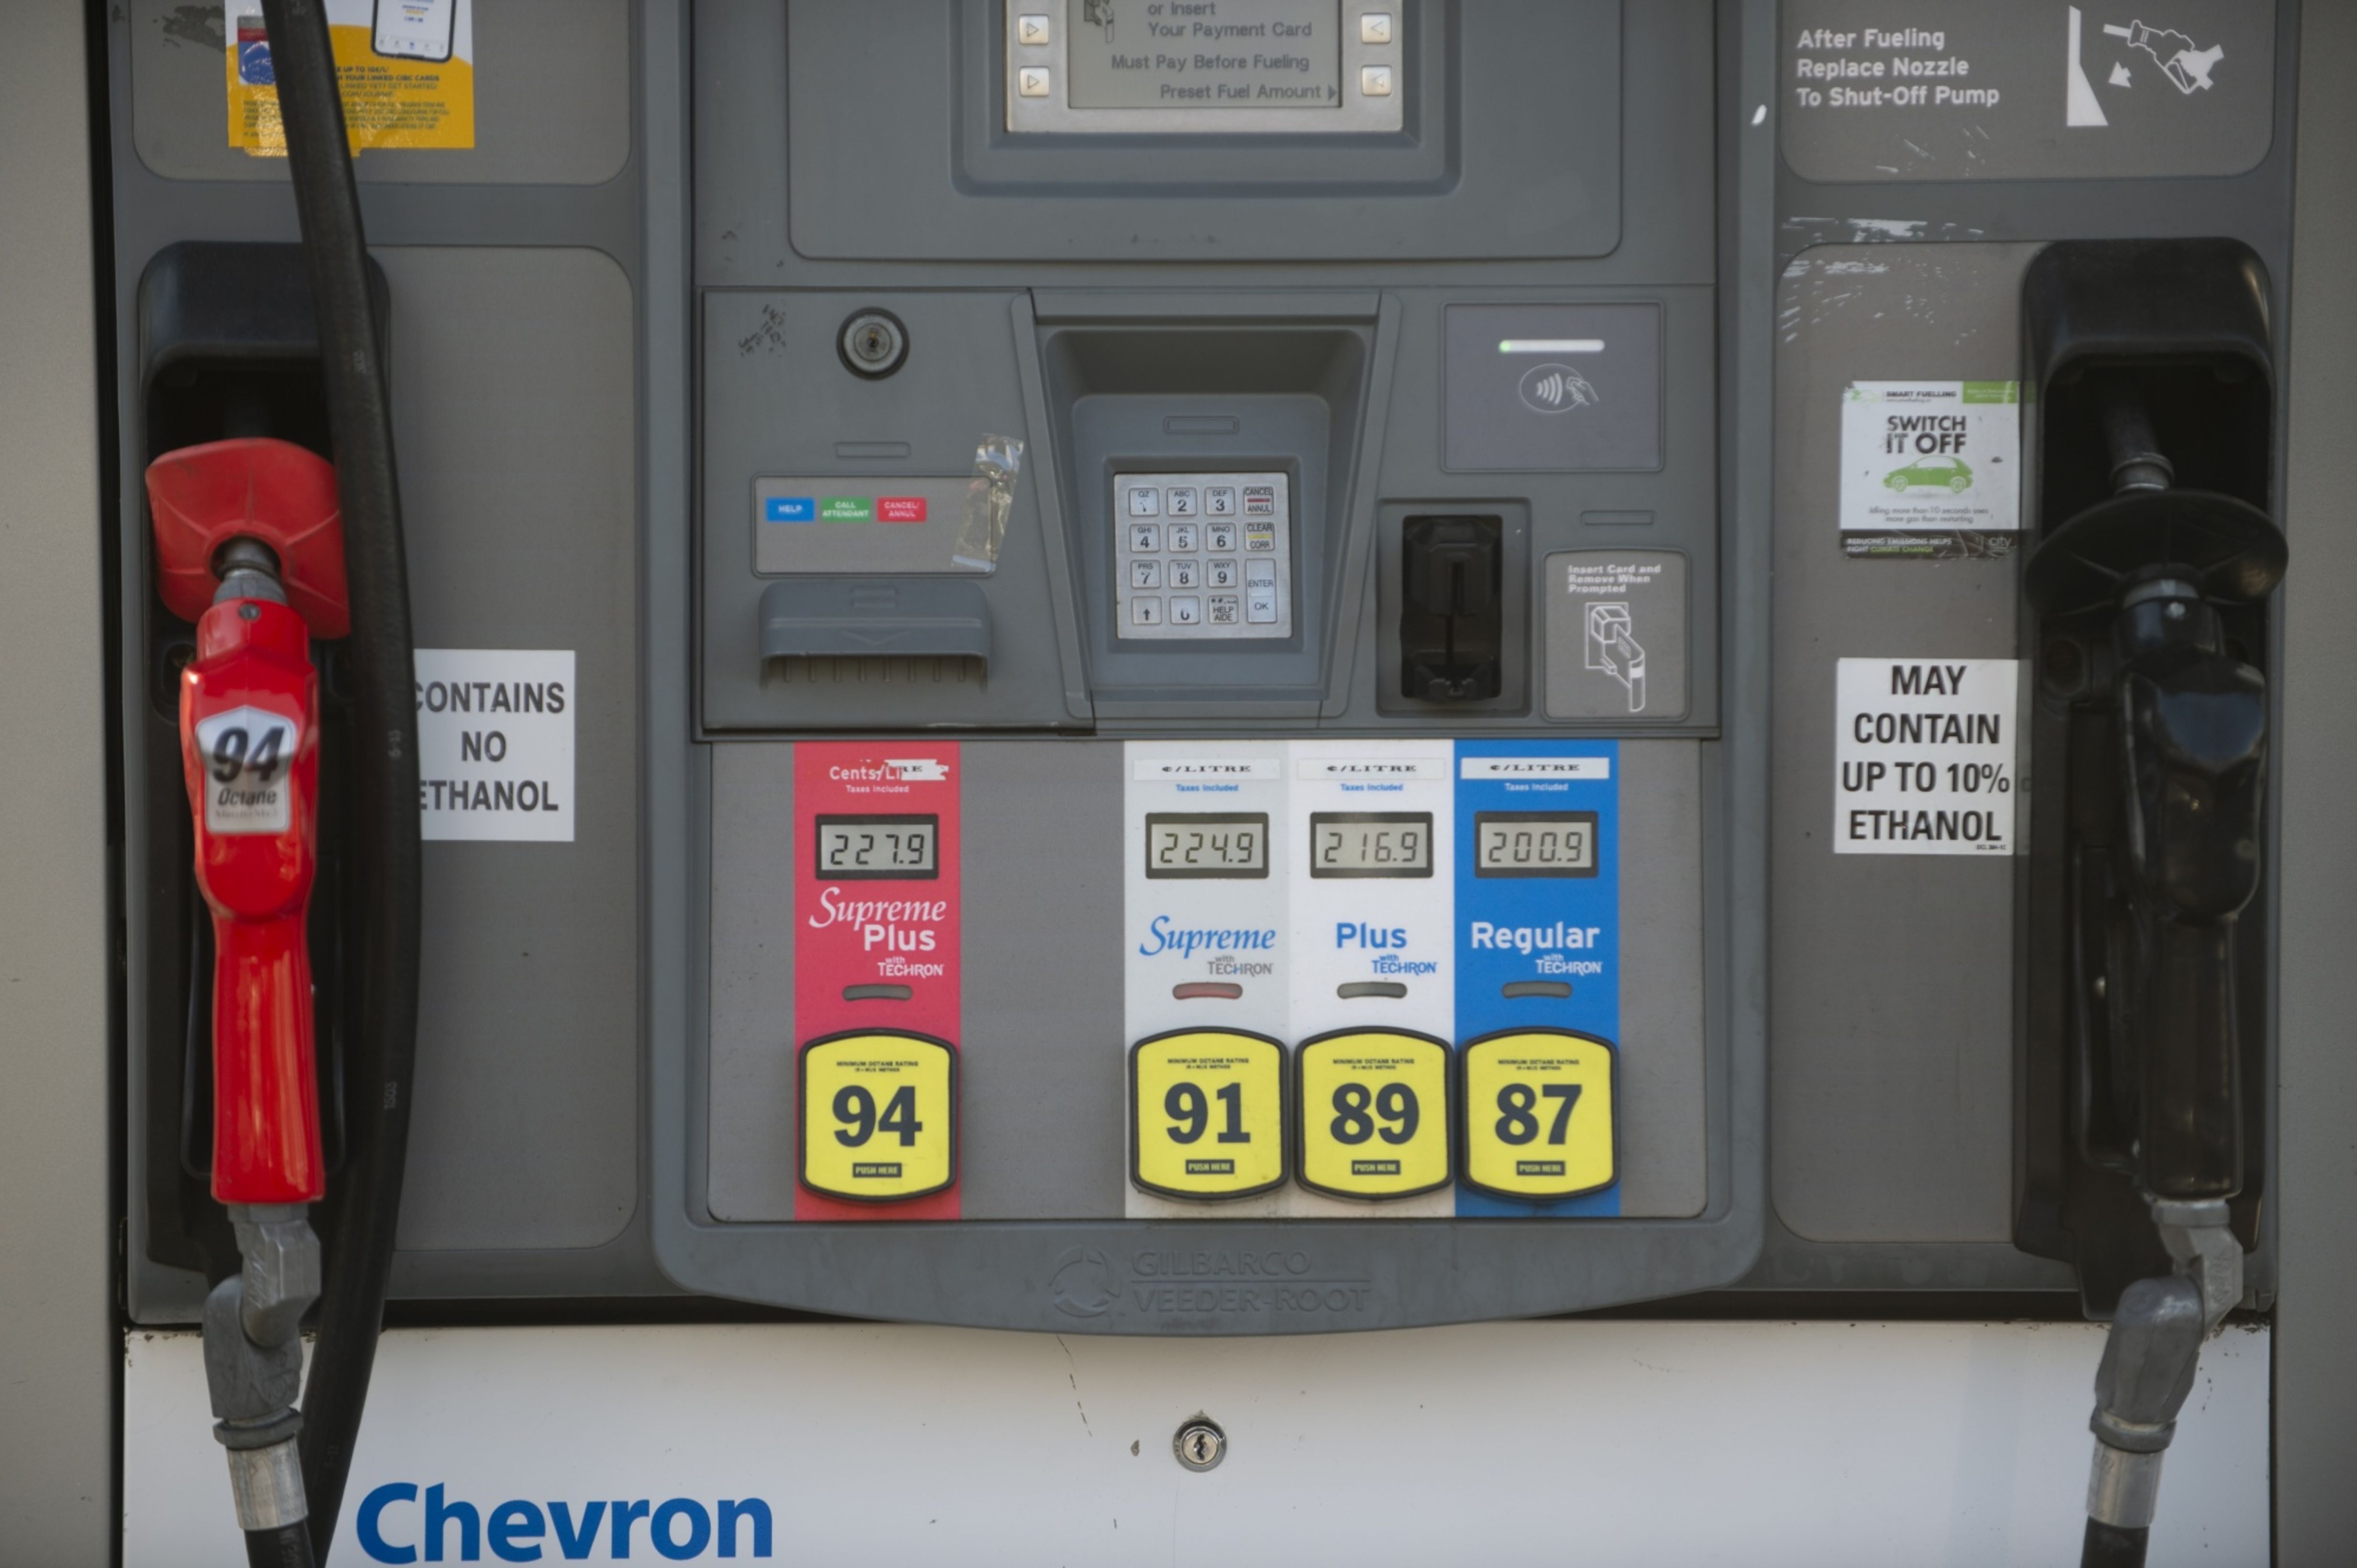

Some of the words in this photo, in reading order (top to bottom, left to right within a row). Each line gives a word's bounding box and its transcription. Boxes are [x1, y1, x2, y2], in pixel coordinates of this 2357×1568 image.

[1147, 3, 1164, 15] or
[1172, 1, 1216, 15] Insert
[1148, 22, 1186, 36] Your
[1193, 22, 1266, 40] Payment
[1272, 22, 1312, 36] Card
[1797, 30, 1856, 48] After
[1864, 29, 1945, 50] Fueling
[1112, 55, 1149, 70] Must
[1156, 55, 1187, 71] Pay
[1194, 55, 1247, 70] Before
[1254, 55, 1310, 72] Fueling
[1797, 58, 1885, 80] Replace
[1893, 57, 1969, 77] Nozzle
[1160, 85, 1212, 100] Preset
[1217, 85, 1249, 99] Fuel
[1257, 85, 1321, 99] Amount
[1797, 88, 1822, 107] To
[1829, 86, 1927, 106] Shut-Off
[1935, 86, 2000, 107] Pump
[1887, 416, 1966, 431] SWITCH
[1886, 433, 1908, 454] IT
[1916, 433, 1966, 454] OFF
[778, 505, 803, 513] HELP
[822, 509, 870, 517] ATTENDANT
[1177, 499, 1187, 512] 2
[1215, 499, 1225, 511] 3
[1140, 536, 1150, 548] 4
[1178, 536, 1188, 548] 5
[1217, 535, 1226, 548] 6
[1141, 572, 1151, 584] 7
[1179, 571, 1189, 584] 8
[1217, 571, 1227, 583] 9
[1568, 565, 1603, 573] Insert
[1607, 565, 1635, 573] Card
[1639, 564, 1662, 573] and
[1568, 575, 1615, 583] Remove
[1618, 574, 1651, 582] When
[1568, 584, 1626, 593] Prompted
[1891, 665, 1967, 695] MAY
[1854, 713, 2001, 744] CONTAIN
[213, 726, 285, 783] 94
[461, 731, 507, 762] NO
[829, 764, 901, 781] Cents/Li
[1843, 761, 1886, 791] UP
[1894, 761, 1937, 792] TO
[1947, 763, 2010, 793] 10%
[218, 788, 276, 806] Octane
[1850, 810, 2002, 841] ETHANOL
[830, 834, 925, 865] 227.9
[1160, 833, 1253, 863] 224.9
[1324, 832, 1418, 863] 216.9
[1489, 832, 1582, 863] 200.9
[809, 887, 947, 931] Supreme
[865, 924, 936, 951] Plus
[1139, 915, 1276, 959] Supreme
[1337, 922, 1407, 949] Plus
[1472, 921, 1600, 955] Regular
[878, 962, 943, 978] TECHRON
[1207, 962, 1272, 977] TECHRON
[1372, 960, 1437, 976] TECHRON
[1535, 960, 1602, 976] TECHRON
[832, 1085, 922, 1148] 94
[1164, 1082, 1251, 1144] 91
[1330, 1082, 1419, 1145] 89
[1495, 1083, 1582, 1145] 87
[855, 1166, 876, 1174] PUSH
[878, 1166, 898, 1174] HERE
[1131, 1250, 1312, 1276] GILBARCO
[356, 1481, 772, 1565] Chevron
